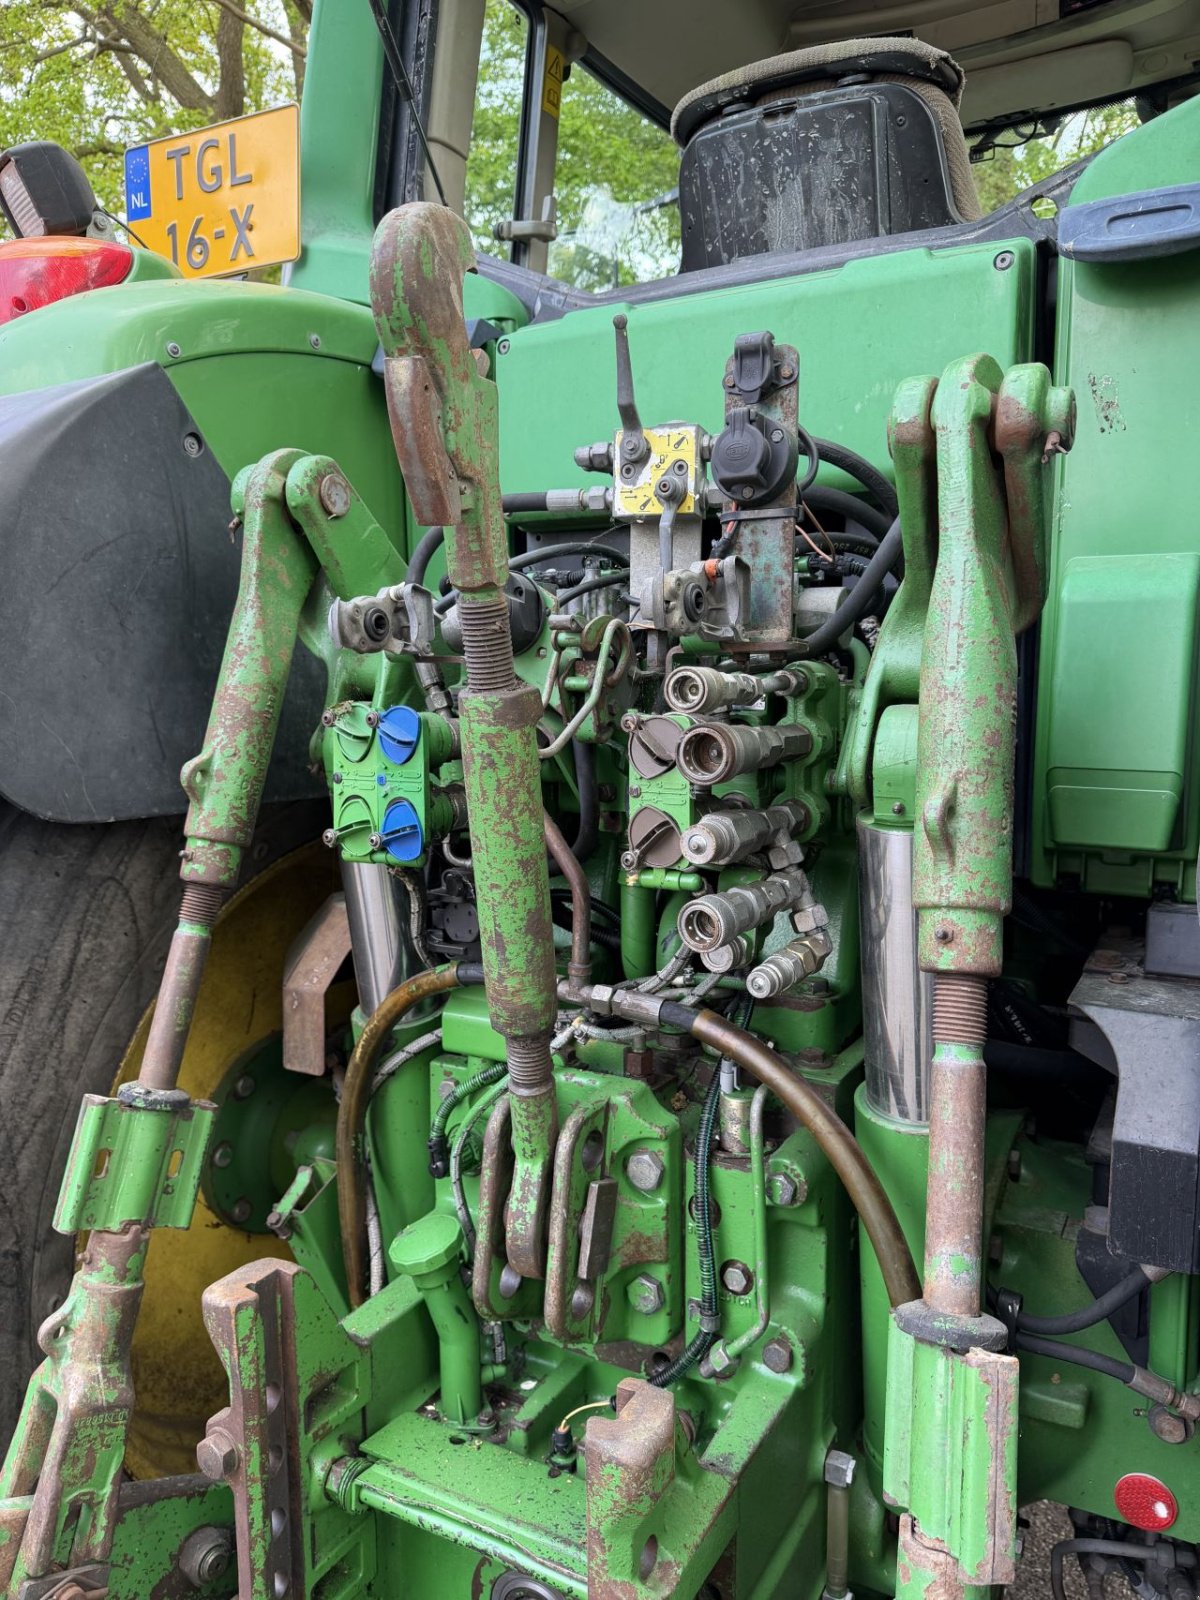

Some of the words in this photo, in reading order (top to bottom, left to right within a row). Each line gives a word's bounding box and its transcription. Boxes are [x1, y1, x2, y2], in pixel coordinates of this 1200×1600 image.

[166, 133, 253, 200] TGL
[131, 192, 148, 209] NL
[167, 204, 254, 270] 16-X
